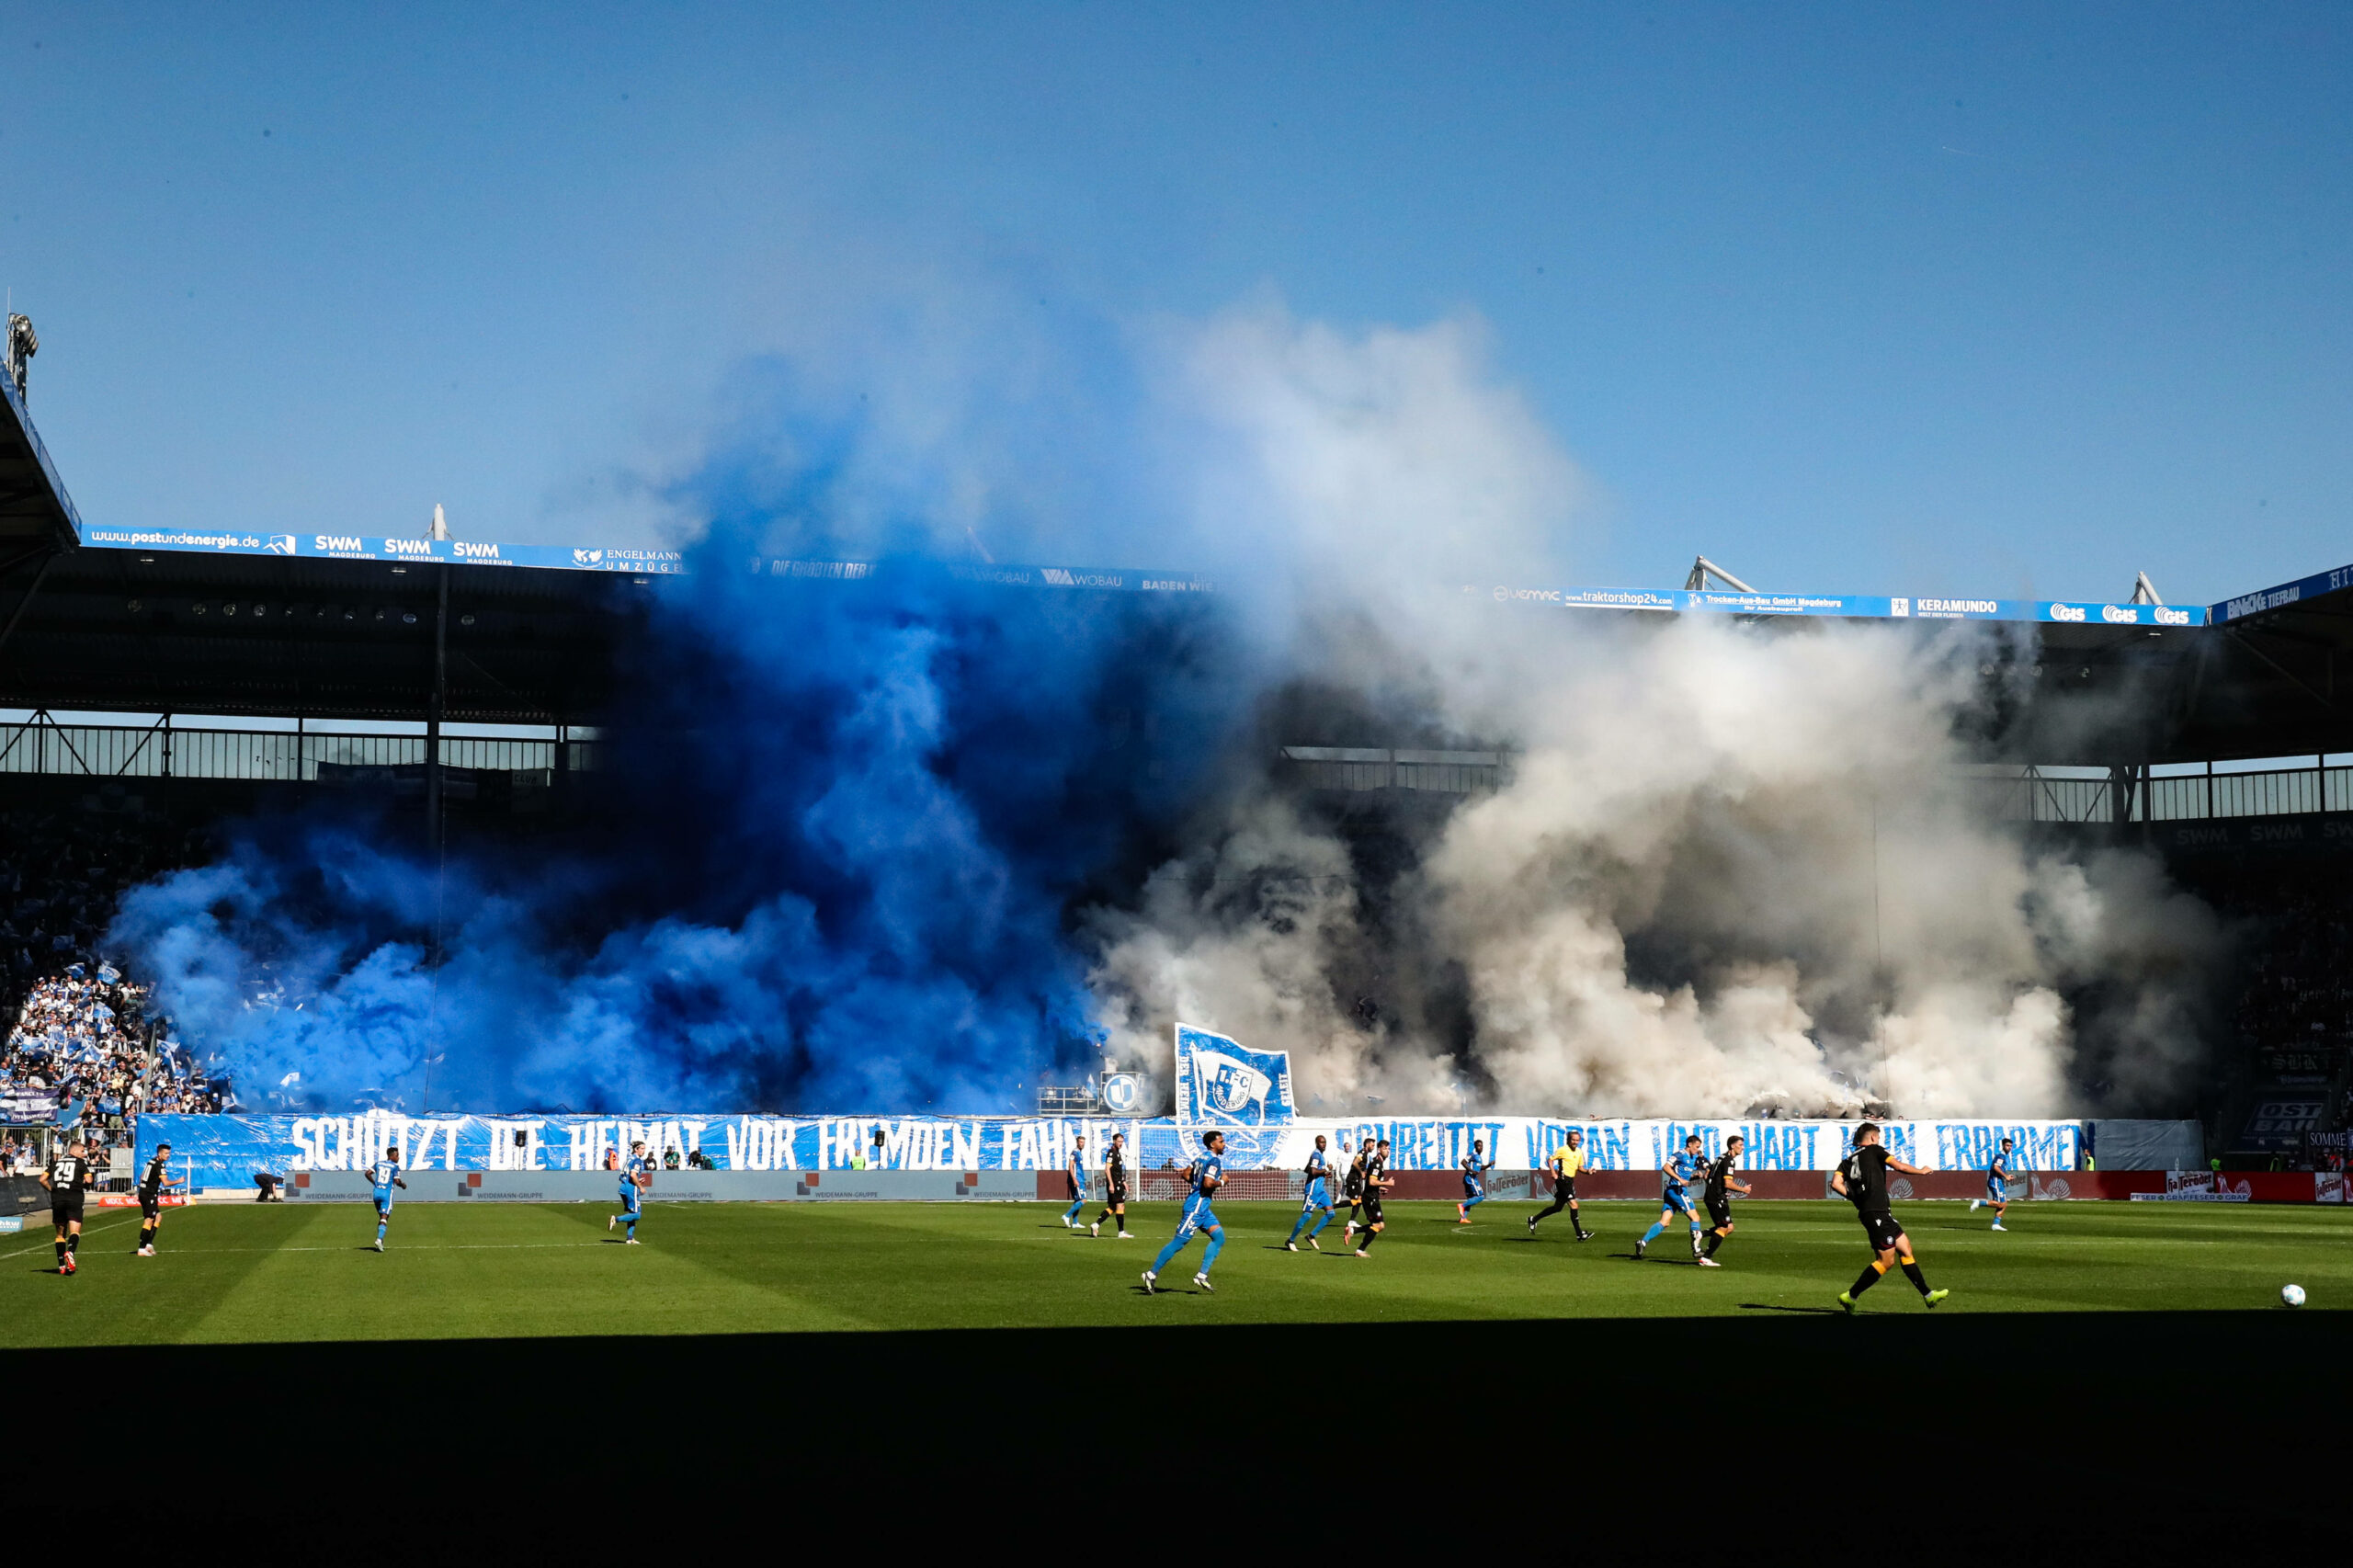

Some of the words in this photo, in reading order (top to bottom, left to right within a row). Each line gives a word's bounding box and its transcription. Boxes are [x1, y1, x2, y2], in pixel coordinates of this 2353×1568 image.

[92, 531, 260, 549] www.postundenergie.de
[315, 536, 362, 551] SWM
[384, 539, 431, 554] SWM
[398, 554, 444, 562] MAGDEBURG
[453, 542, 500, 558] SWM
[608, 549, 682, 562] ENGELMANN
[1074, 571, 1122, 587] WOBAU
[1142, 580, 1185, 591] BADEN
[1566, 591, 1672, 606] www.traktorshop24.com
[1772, 597, 1796, 606] GmbH
[1798, 598, 1842, 608] Magdeburg
[2268, 586, 2300, 609] TIEFBAU
[1917, 599, 1996, 613] KERAMUNDO
[2060, 608, 2086, 621] GIS
[2112, 608, 2138, 623] GIS
[2164, 610, 2189, 625] GIS
[2177, 827, 2228, 845] SWM
[2251, 824, 2303, 841] SWM
[291, 1108, 468, 1171] SCHÜTZT
[489, 1119, 549, 1171] DIE
[565, 1120, 708, 1171] HEIMAT
[727, 1115, 797, 1171] VOR
[817, 1117, 982, 1171] FREMDEN
[1002, 1119, 1141, 1171] FAHNEN
[1740, 1122, 1820, 1171] HABT
[1839, 1123, 1916, 1169] KIN
[1935, 1122, 2096, 1171] ERBARMEN
[54, 1161, 76, 1182] 29
[378, 1166, 392, 1184] 19
[1849, 1154, 1862, 1180] 4
[2167, 1173, 2212, 1193] Haseröder
